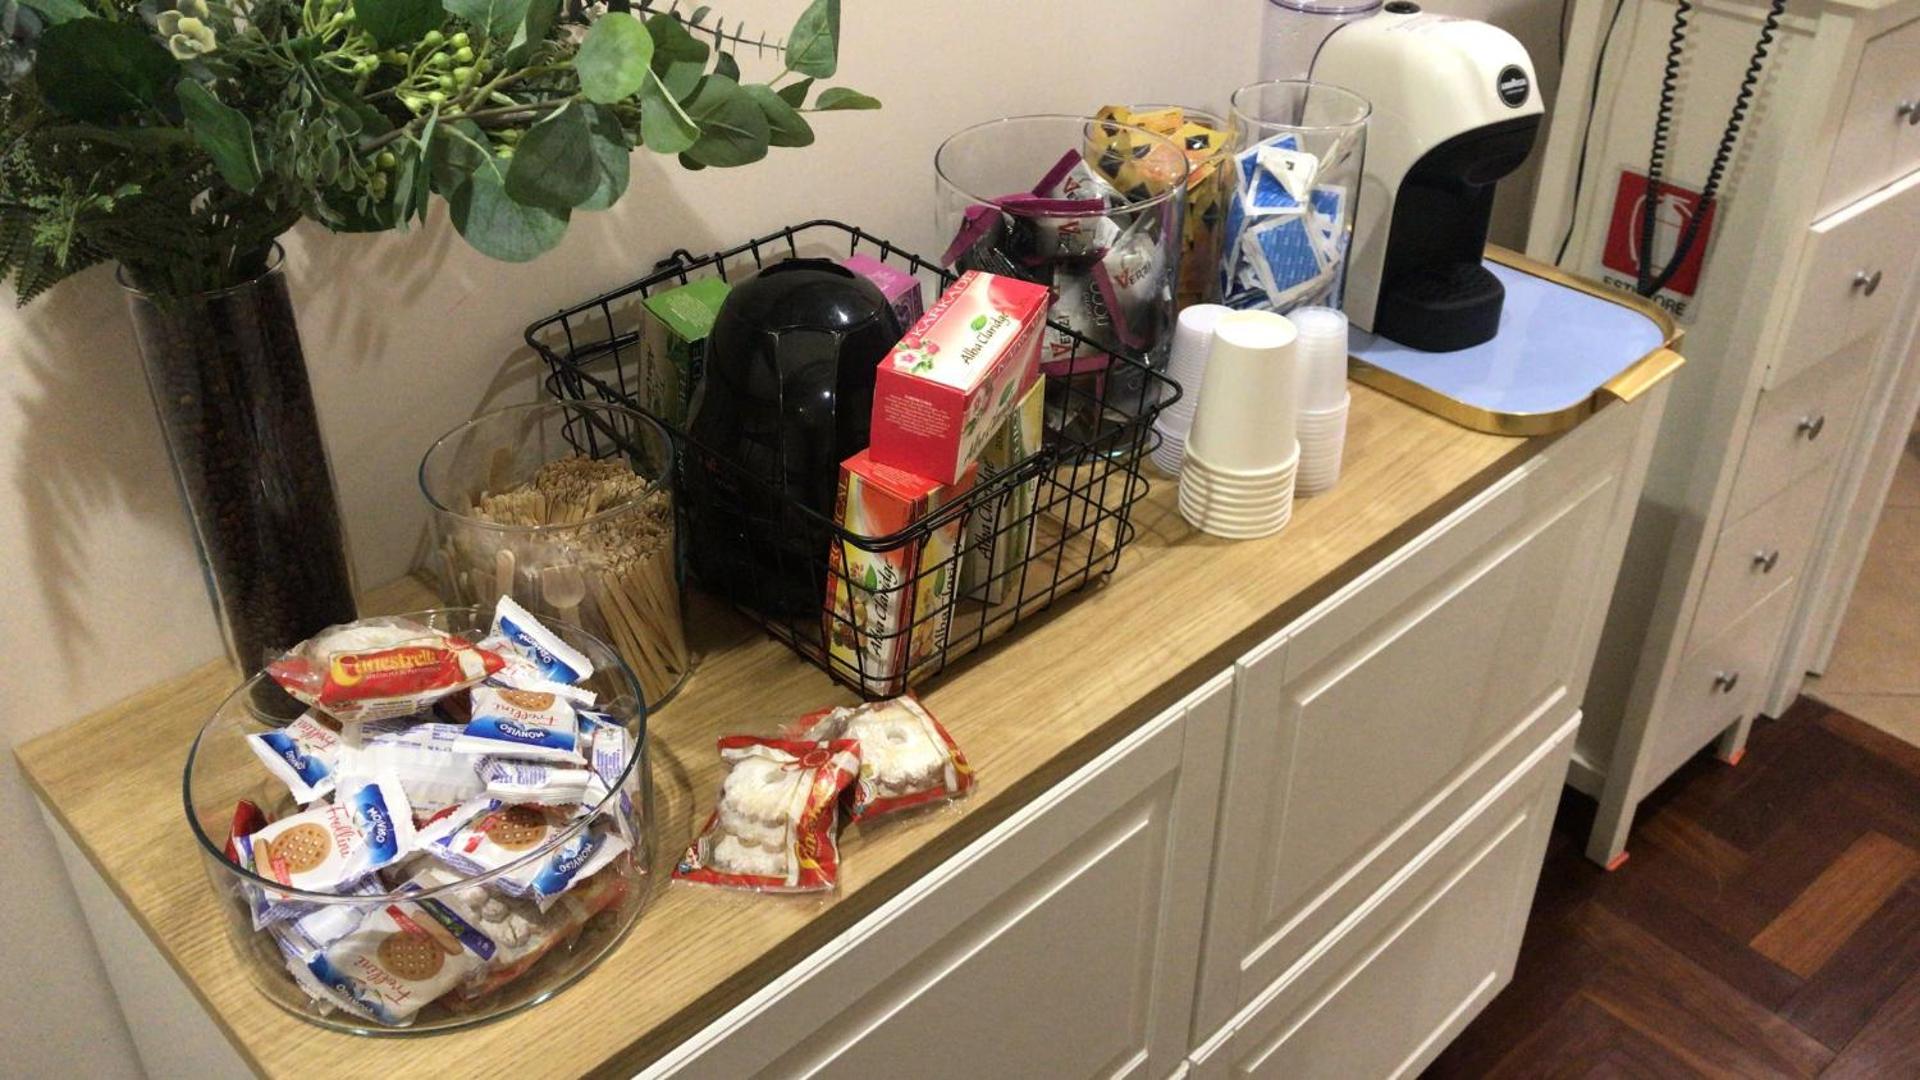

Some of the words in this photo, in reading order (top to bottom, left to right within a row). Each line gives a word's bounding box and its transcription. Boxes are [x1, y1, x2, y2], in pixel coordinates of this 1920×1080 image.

[1603, 276, 1688, 316] ESTORE
[960, 338, 983, 364] Alba
[499, 722, 545, 739] MONVISO
